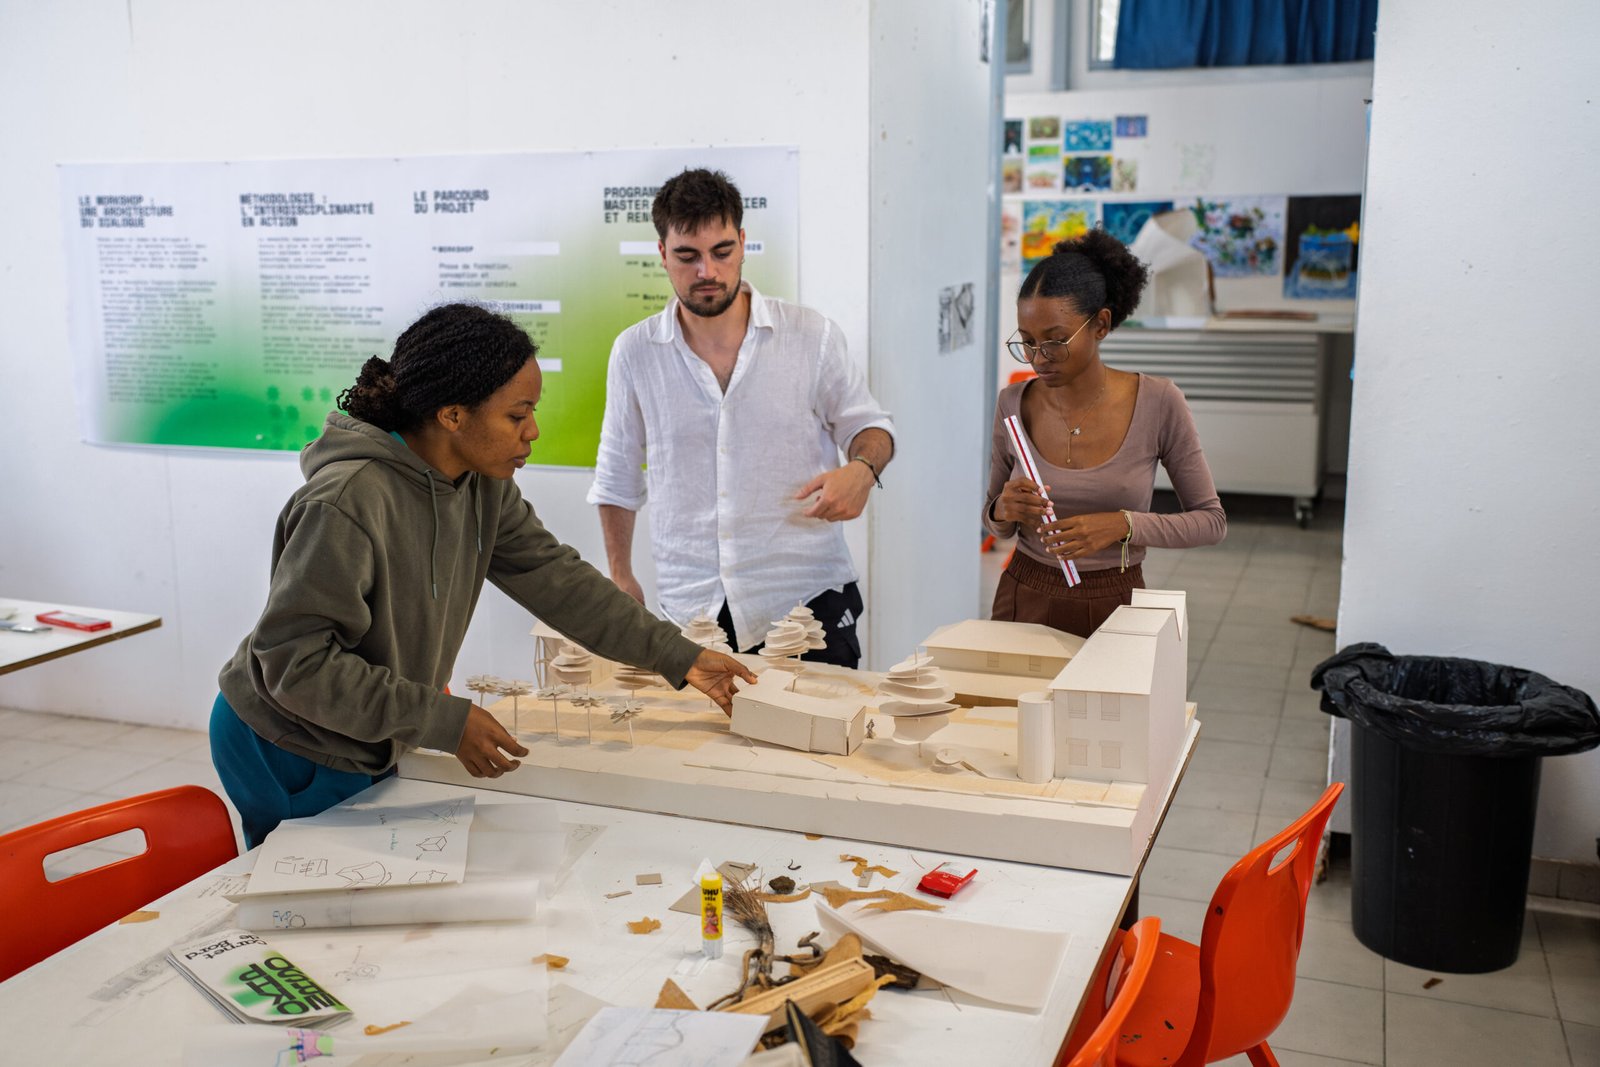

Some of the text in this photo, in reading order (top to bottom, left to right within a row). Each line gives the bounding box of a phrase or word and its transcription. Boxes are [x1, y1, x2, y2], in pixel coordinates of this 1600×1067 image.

[79, 195, 90, 206] LE
[96, 194, 144, 205] WORKSHOP
[413, 189, 489, 202] LE PARCOURS
[80, 205, 173, 216] UNE ARCHITECTURE
[414, 202, 474, 214] DU PROJET
[81, 217, 145, 228] DU DIALOGUE
[241, 216, 298, 227] EN ACTION
[604, 211, 651, 223] ET REN
[185, 939, 229, 960] Bord
